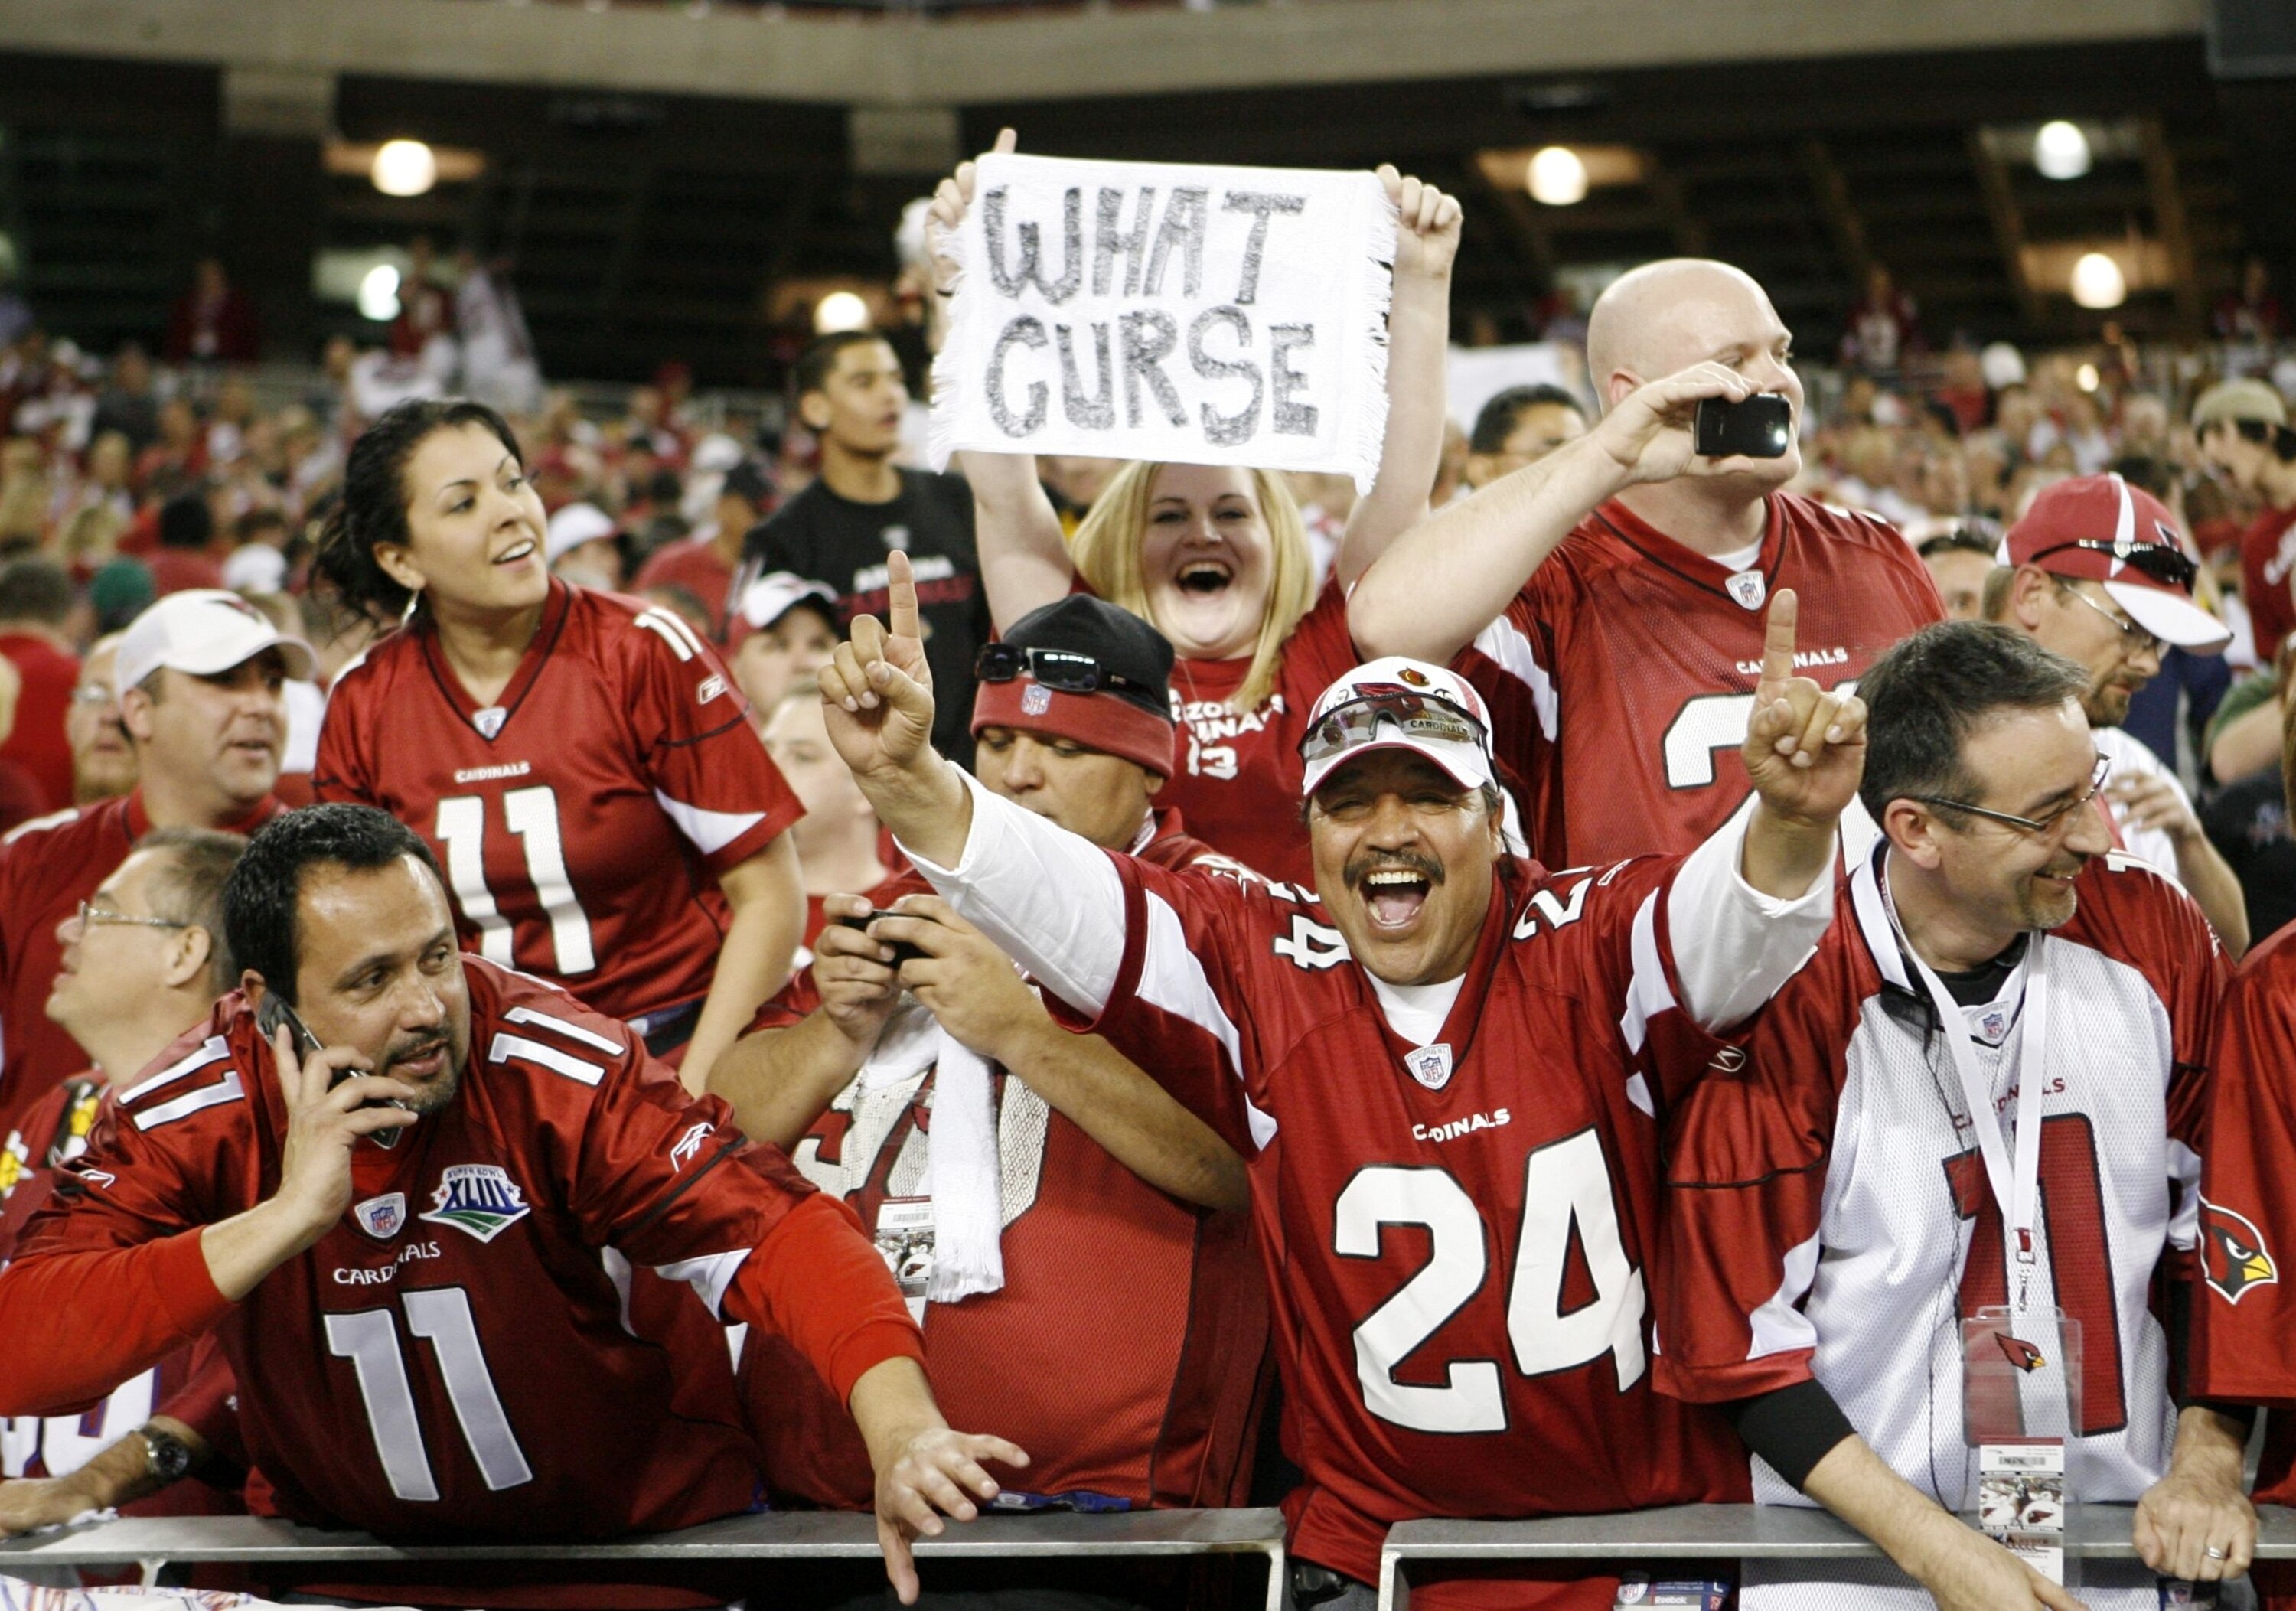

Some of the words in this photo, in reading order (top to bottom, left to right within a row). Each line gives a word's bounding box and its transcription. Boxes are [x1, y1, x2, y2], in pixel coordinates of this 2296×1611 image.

[983, 185, 1308, 306] WHAT
[985, 305, 1319, 448] CURSE
[1736, 647, 1848, 674] CANALS
[435, 785, 596, 975] 11
[119, 1035, 246, 1131] 11
[489, 1006, 625, 1086] 11
[1424, 1067, 1444, 1081] NFL
[442, 1177, 515, 1212] XLIII
[1334, 1125, 1647, 1434] 24
[322, 1287, 533, 1502] 11
[1655, 1595, 1688, 1605] Reebok
